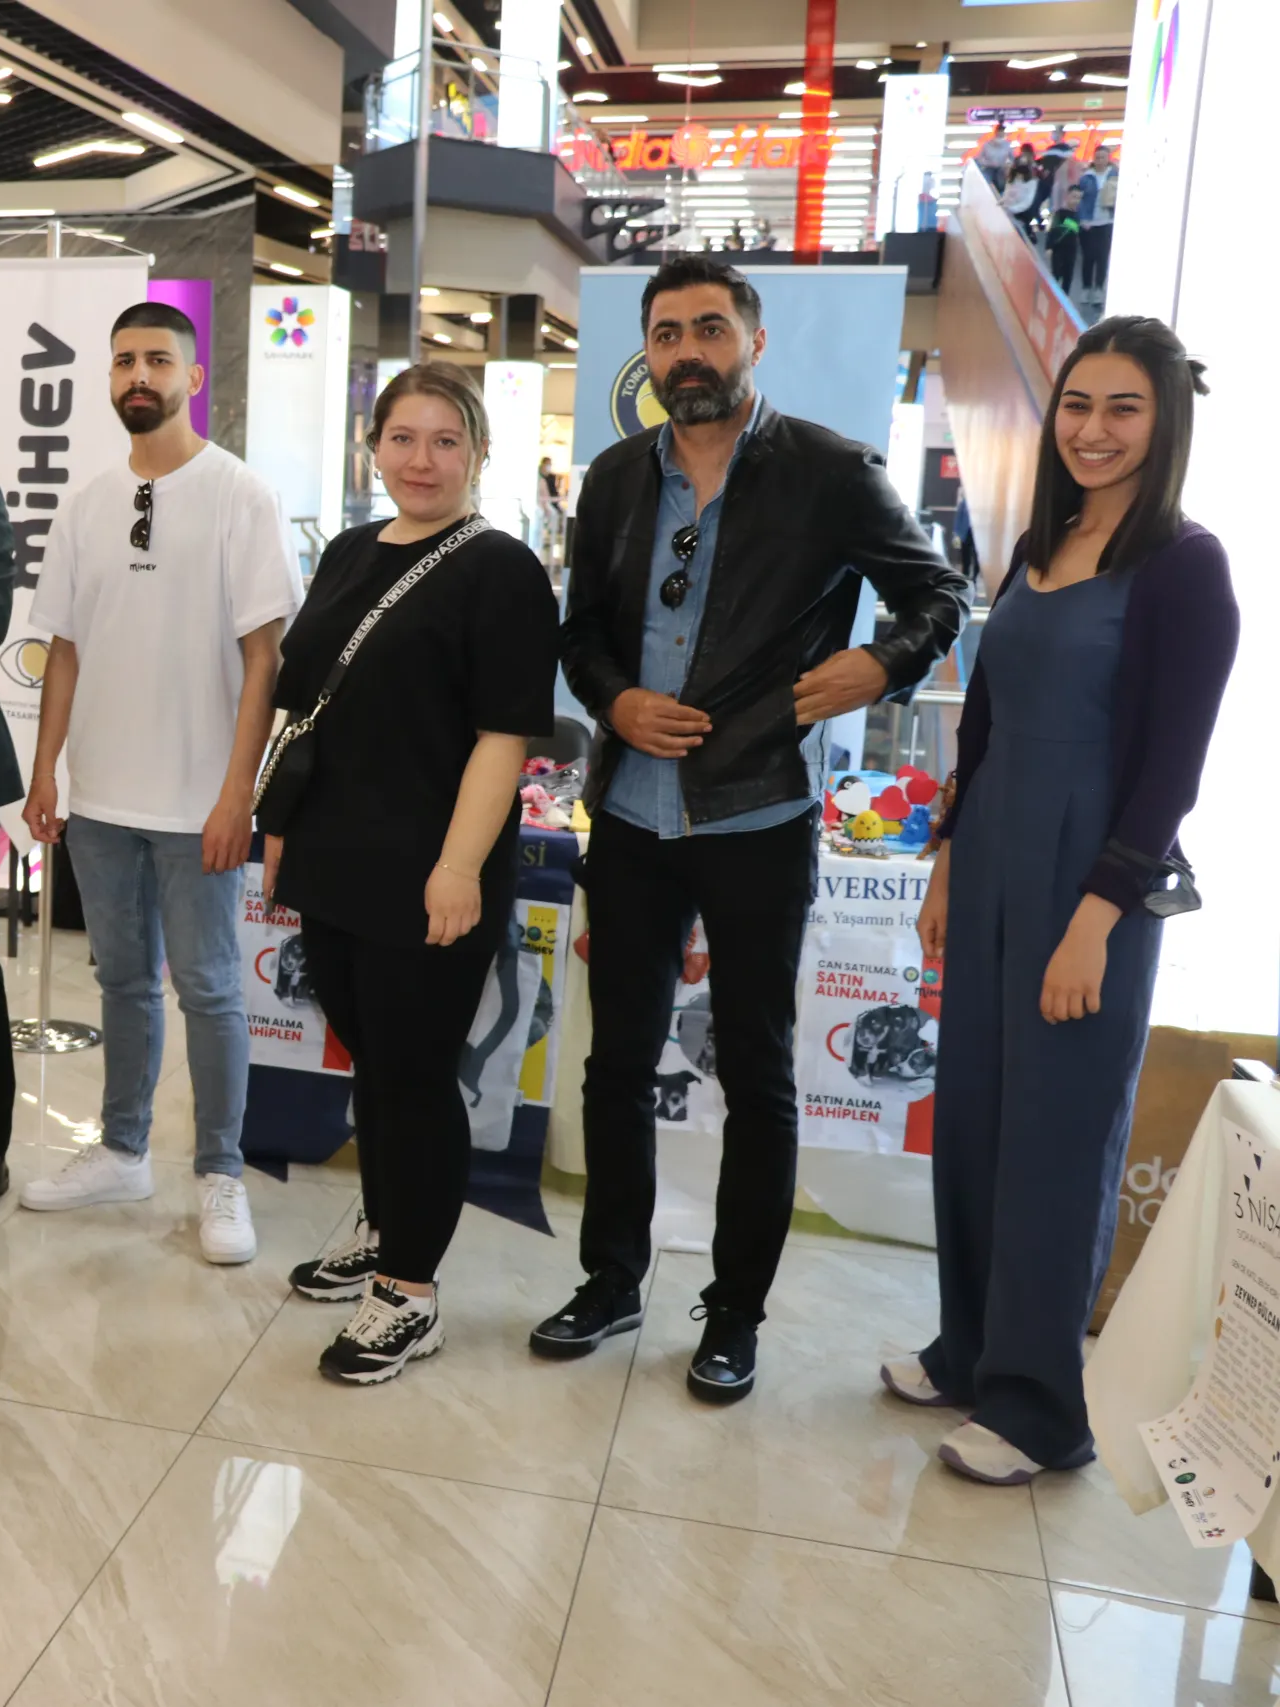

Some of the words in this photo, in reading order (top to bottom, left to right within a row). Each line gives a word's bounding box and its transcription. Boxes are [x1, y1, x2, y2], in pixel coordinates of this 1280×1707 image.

[378, 550, 441, 608] ACADEMIA
[340, 609, 384, 665] ADEMIA
[818, 960, 843, 970] CAN
[845, 963, 899, 977] SATILMAZ
[816, 971, 864, 987] SATIN
[815, 984, 901, 1006] ALINAMAZ
[272, 1018, 305, 1030] ALMA
[805, 1093, 844, 1107] SATIN
[846, 1099, 883, 1111] ALMA
[1233, 1191, 1244, 1219] 3
